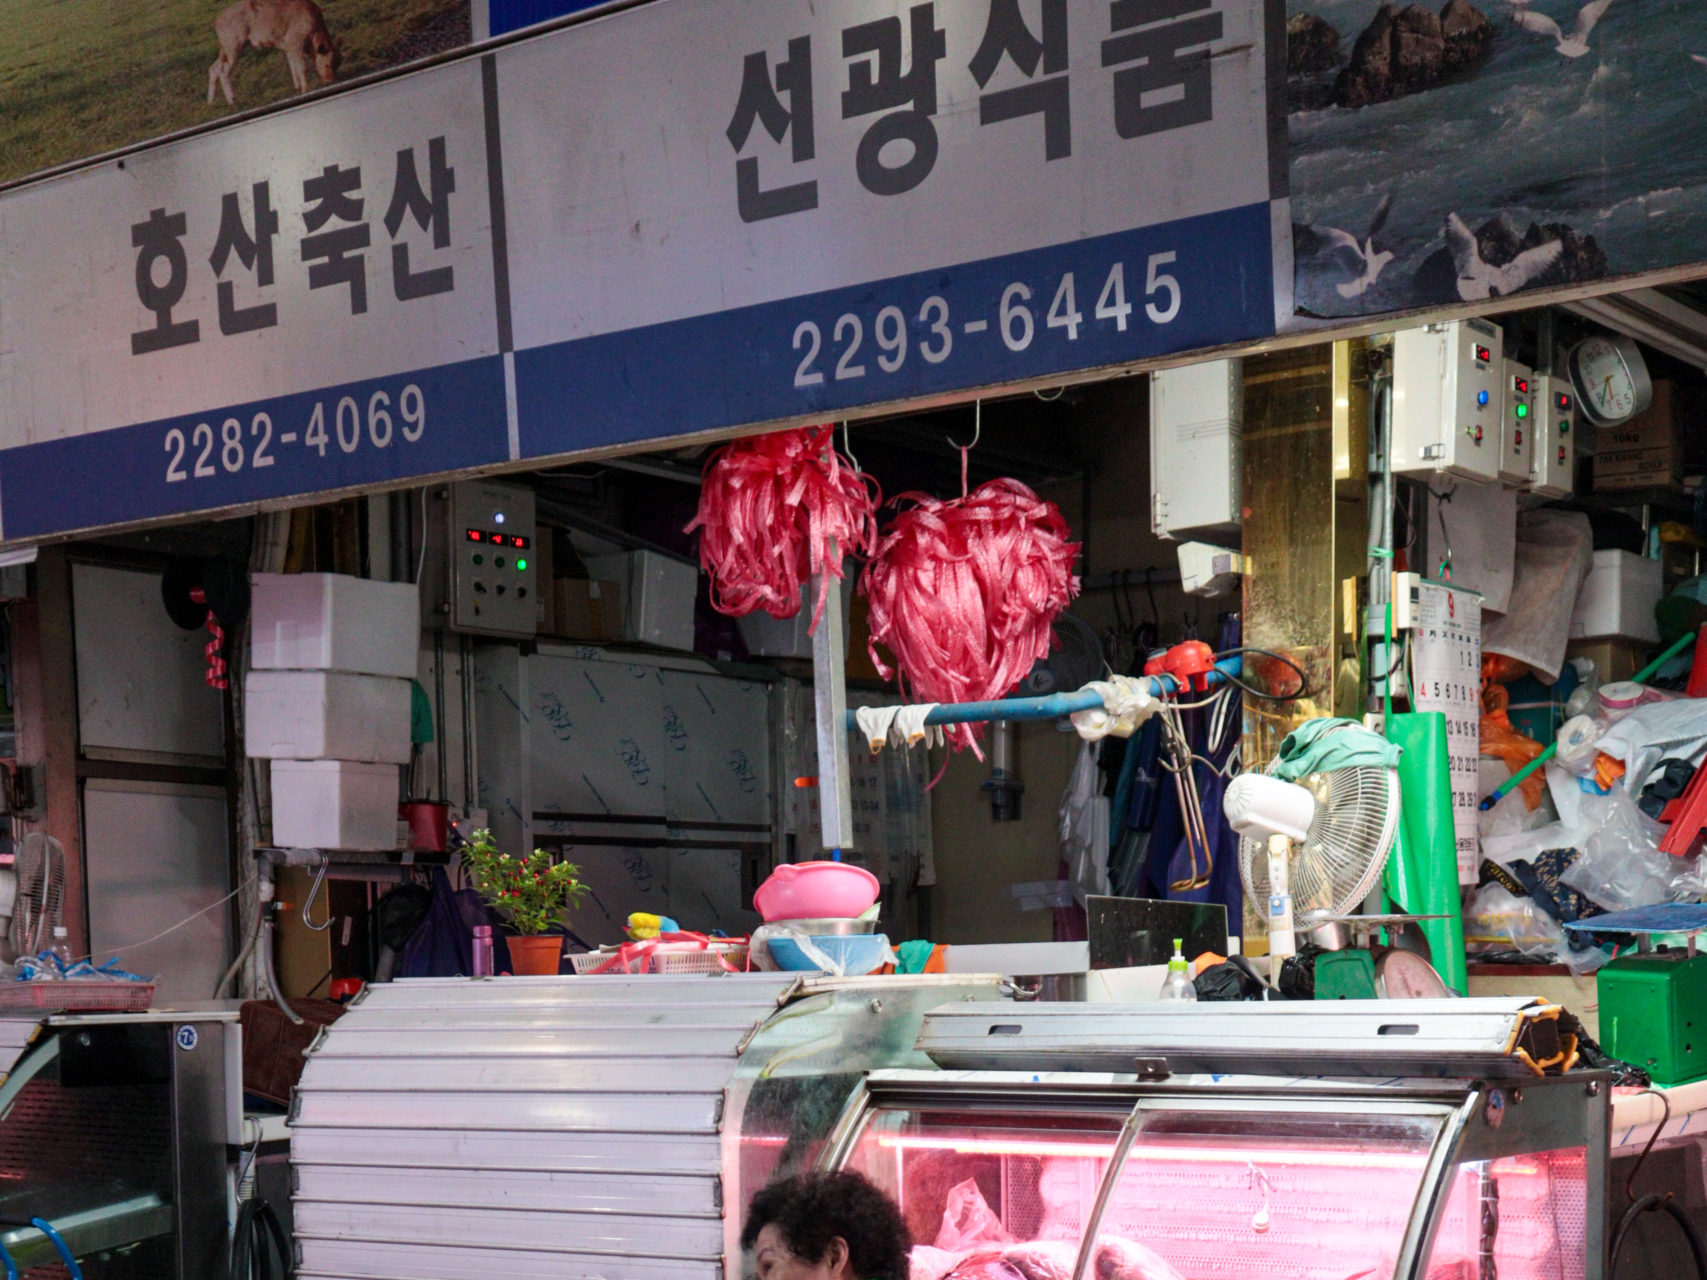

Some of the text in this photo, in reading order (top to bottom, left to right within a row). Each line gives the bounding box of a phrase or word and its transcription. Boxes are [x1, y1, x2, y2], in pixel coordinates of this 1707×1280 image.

[725, 0, 1224, 224] 선광식품
[130, 135, 457, 356] 호산축산
[791, 249, 1182, 389] 2293-6445
[164, 383, 427, 483] 2282-4069
[1448, 591, 1455, 618] 9
